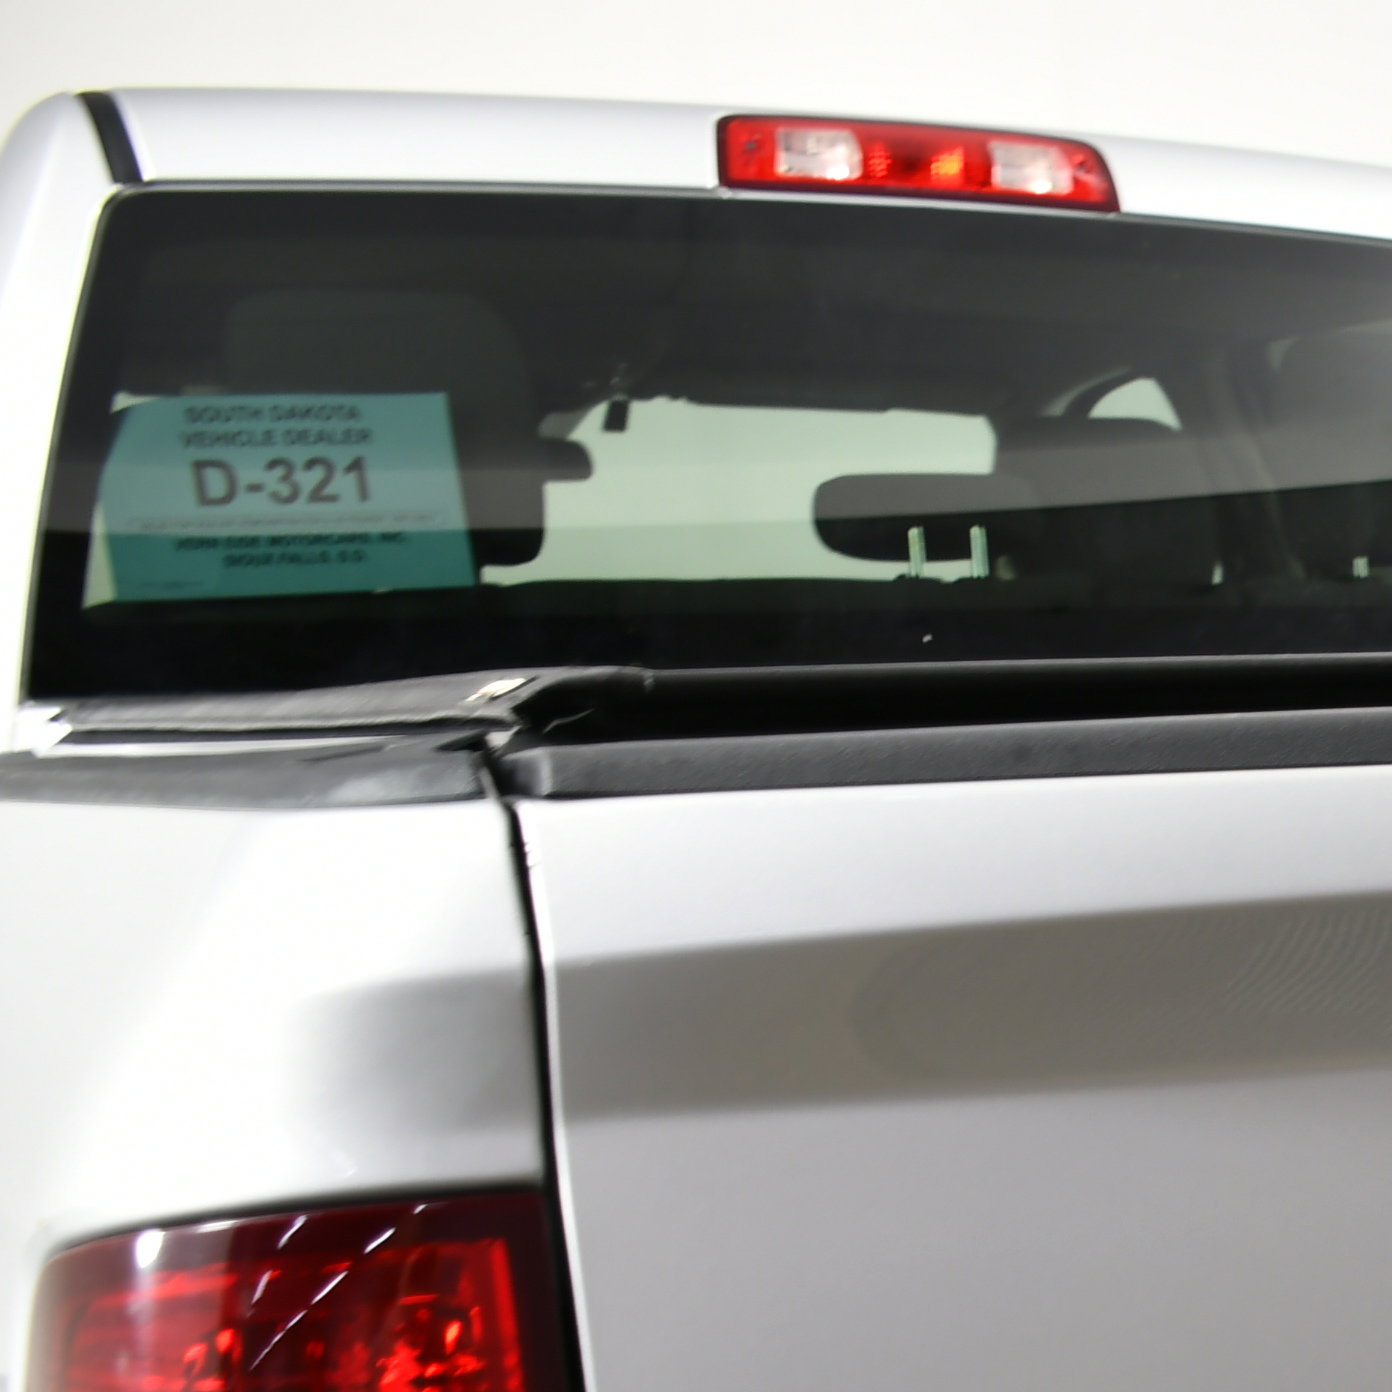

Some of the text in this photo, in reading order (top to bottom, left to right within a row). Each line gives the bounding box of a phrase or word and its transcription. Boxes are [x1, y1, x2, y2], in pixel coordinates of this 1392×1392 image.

[184, 403, 362, 425] SOUTH DAKOTA
[180, 428, 373, 449] VEHICLE DEALER
[191, 456, 371, 507] D-321
